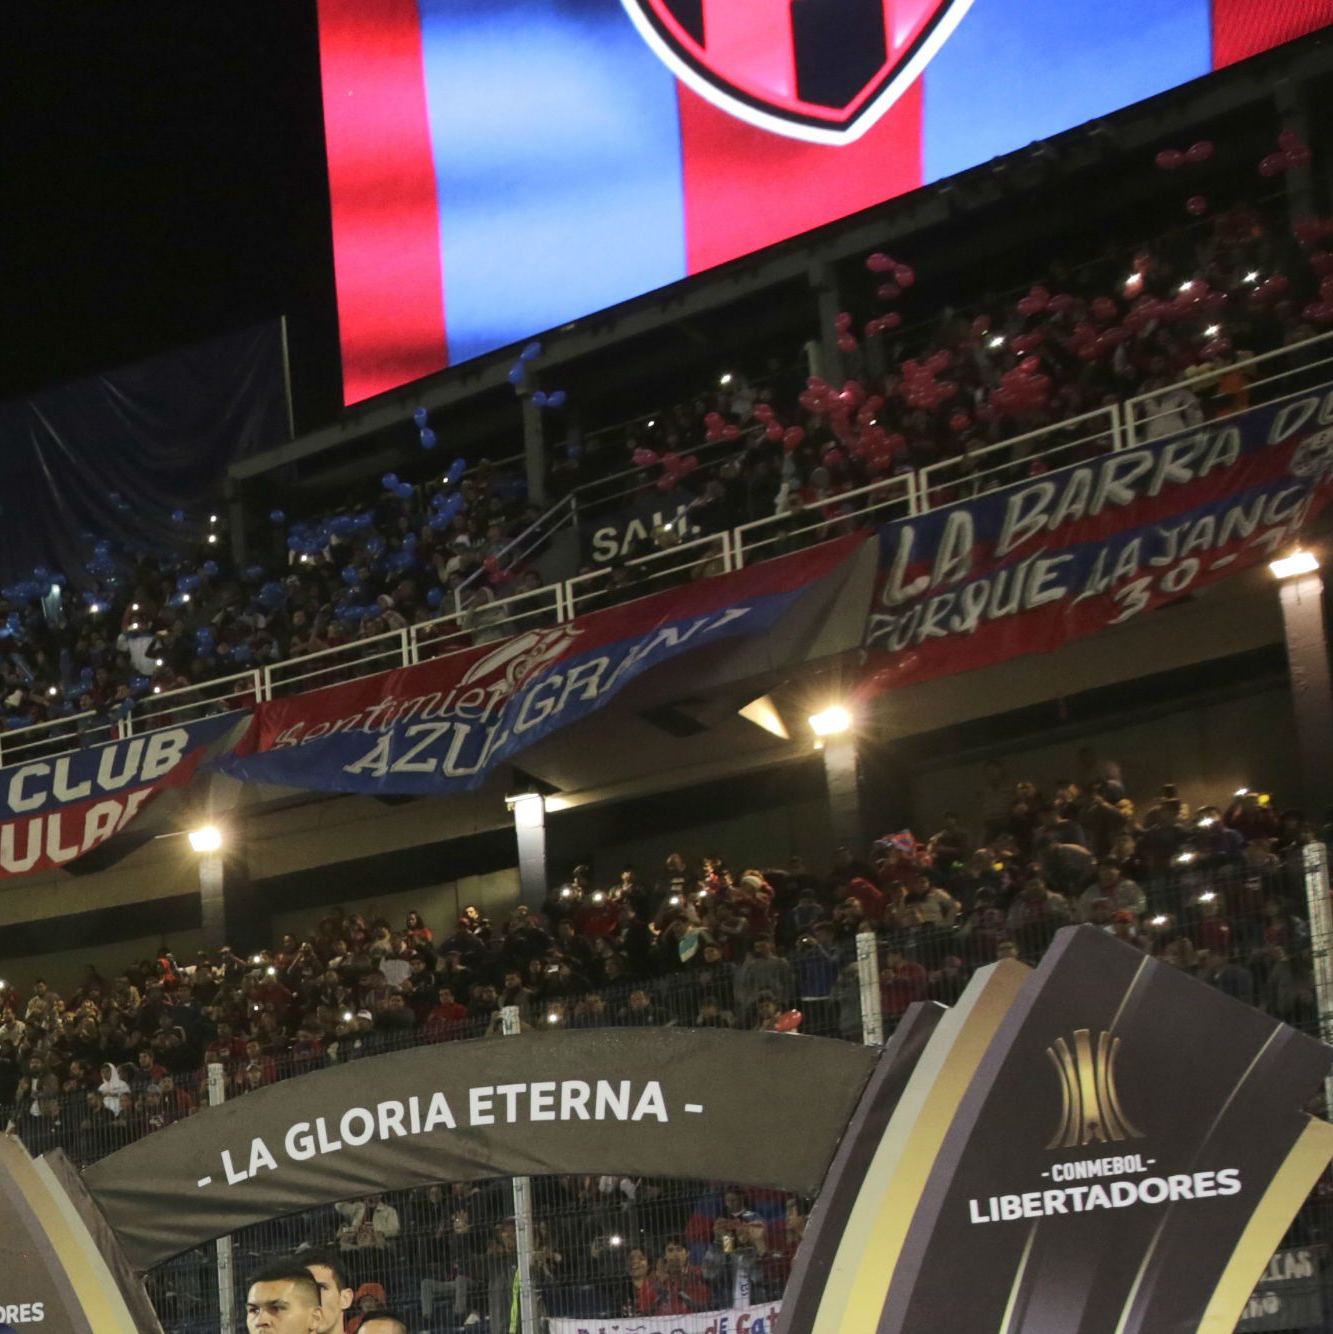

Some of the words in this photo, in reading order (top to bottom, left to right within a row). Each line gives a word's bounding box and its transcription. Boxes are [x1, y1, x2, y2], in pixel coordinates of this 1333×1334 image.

[883, 510, 974, 607] LA
[994, 426, 1241, 559] BARRA
[7, 728, 190, 814] CLUB
[220, 1137, 278, 1186] LA
[284, 1092, 457, 1162] GLORIA
[469, 1079, 669, 1126] ETERNA
[969, 1168, 1243, 1224] LIBERTADORES
